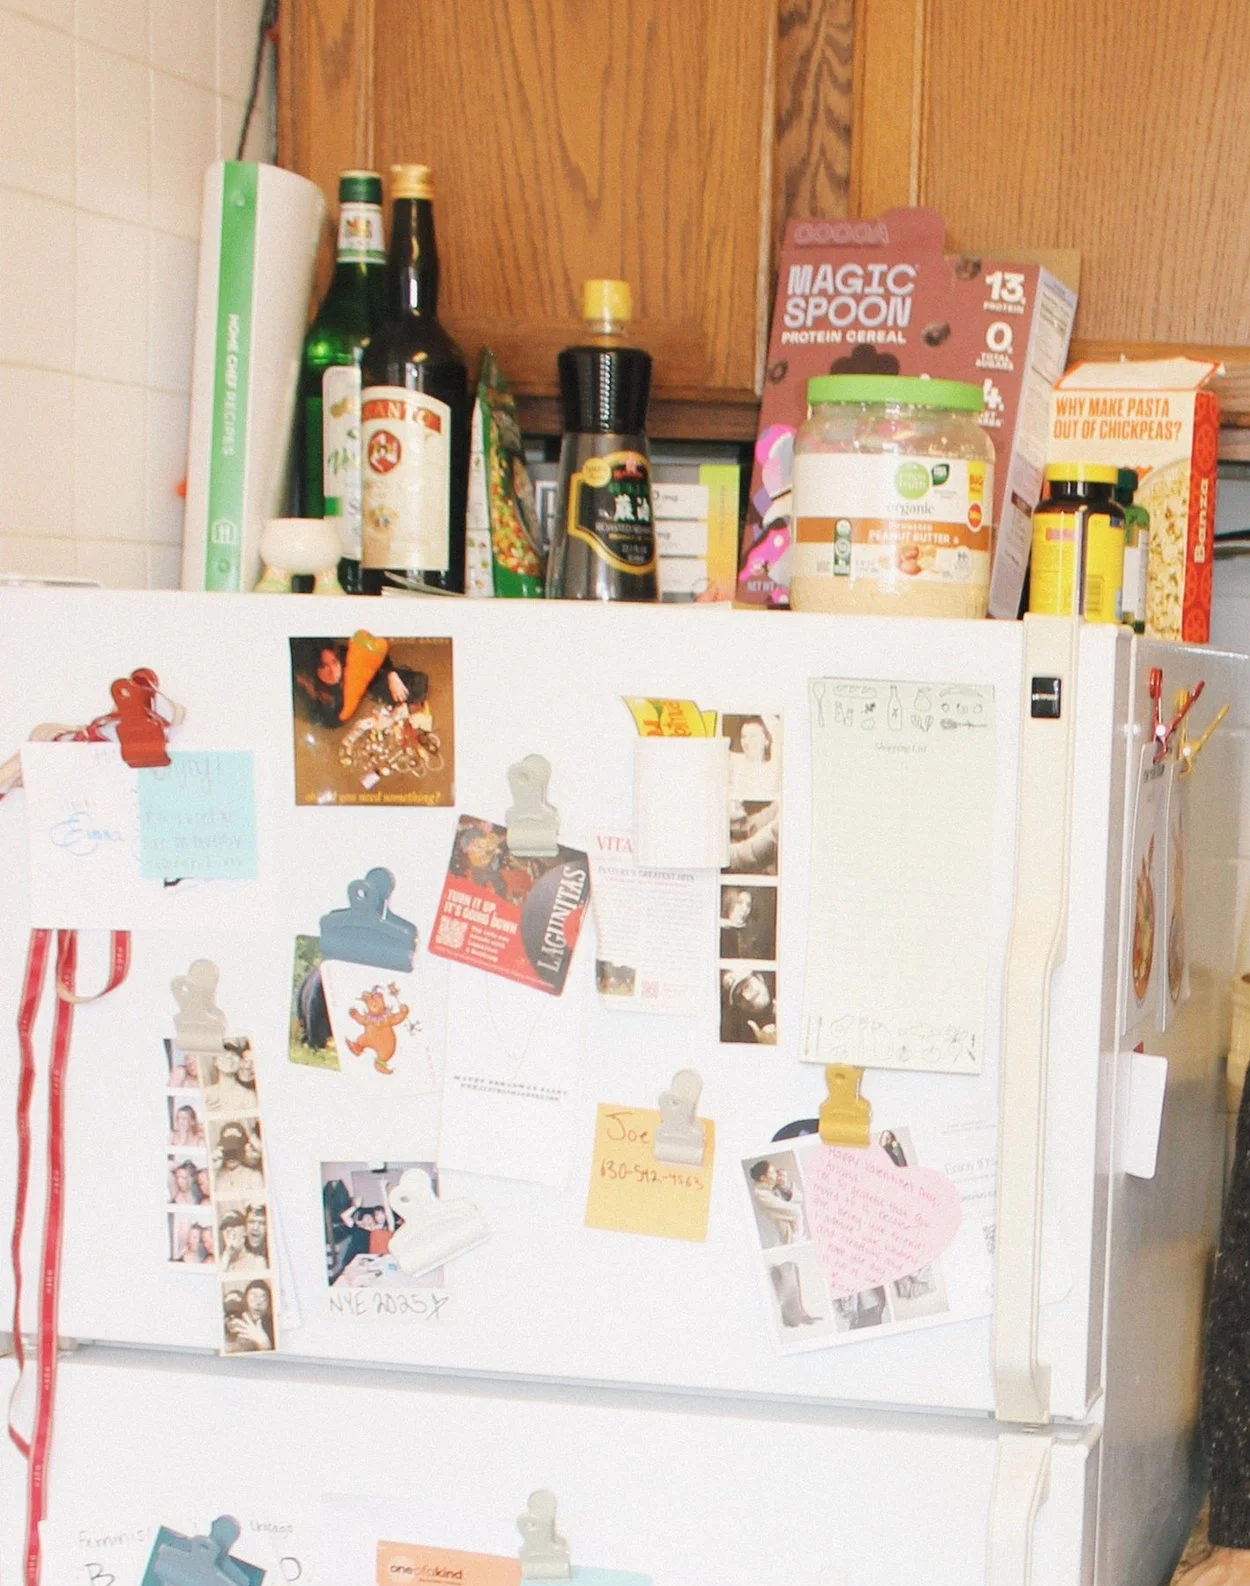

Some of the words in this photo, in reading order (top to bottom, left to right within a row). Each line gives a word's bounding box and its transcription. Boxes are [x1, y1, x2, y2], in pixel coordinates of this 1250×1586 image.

[787, 263, 917, 296] MAGIC
[784, 295, 912, 328] SPOON
[781, 330, 842, 344] PROTEIN
[845, 330, 907, 344] CEREAL
[1056, 397, 1084, 417] WHY
[1088, 397, 1124, 417] MAKE
[1127, 397, 1170, 417] PASTA
[1053, 420, 1078, 440] OUT
[1082, 420, 1096, 440] OF
[1098, 420, 1182, 440] CHICKPEAS?
[886, 502, 936, 517] organic
[913, 532, 950, 545] BUTTER
[537, 865, 587, 973] LAGUNITAS
[606, 1111, 649, 1144] Joe
[329, 1292, 368, 1314] NYE
